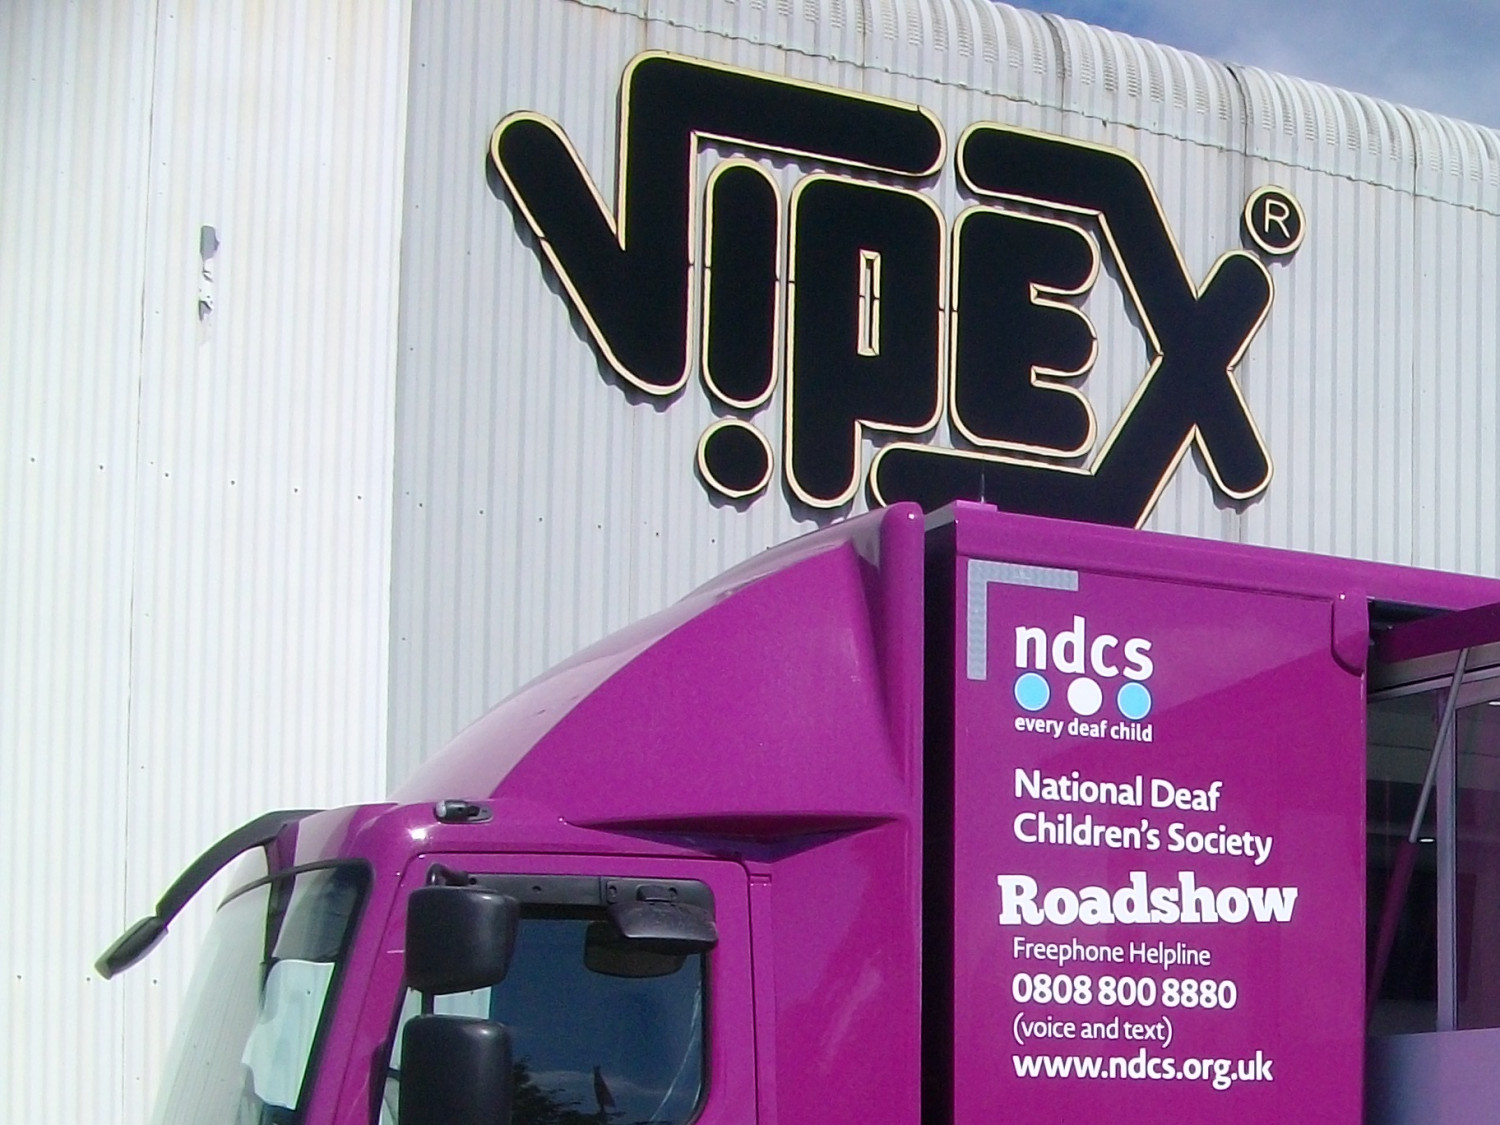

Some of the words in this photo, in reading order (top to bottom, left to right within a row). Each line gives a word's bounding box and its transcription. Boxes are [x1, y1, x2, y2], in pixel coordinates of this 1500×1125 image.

[1015, 615, 1154, 681] ndcs
[1014, 716, 1064, 739] every
[1067, 717, 1108, 738] deaf
[1110, 721, 1154, 742] child
[1014, 768, 1143, 807] National
[1150, 778, 1223, 812] Deaf
[1167, 822, 1273, 866] Society
[997, 870, 1299, 926] Roadshow
[1012, 936, 1125, 967] Freephone
[1129, 941, 1212, 971] Helpline
[1011, 972, 1092, 1005] 0808
[1097, 975, 1157, 1007] 800
[1161, 977, 1237, 1010] 8880
[1012, 1011, 1076, 1046] (voice
[1080, 1016, 1119, 1041] and
[1123, 1015, 1173, 1049] text)
[1012, 1047, 1274, 1091] www.ndcs.org.uk
